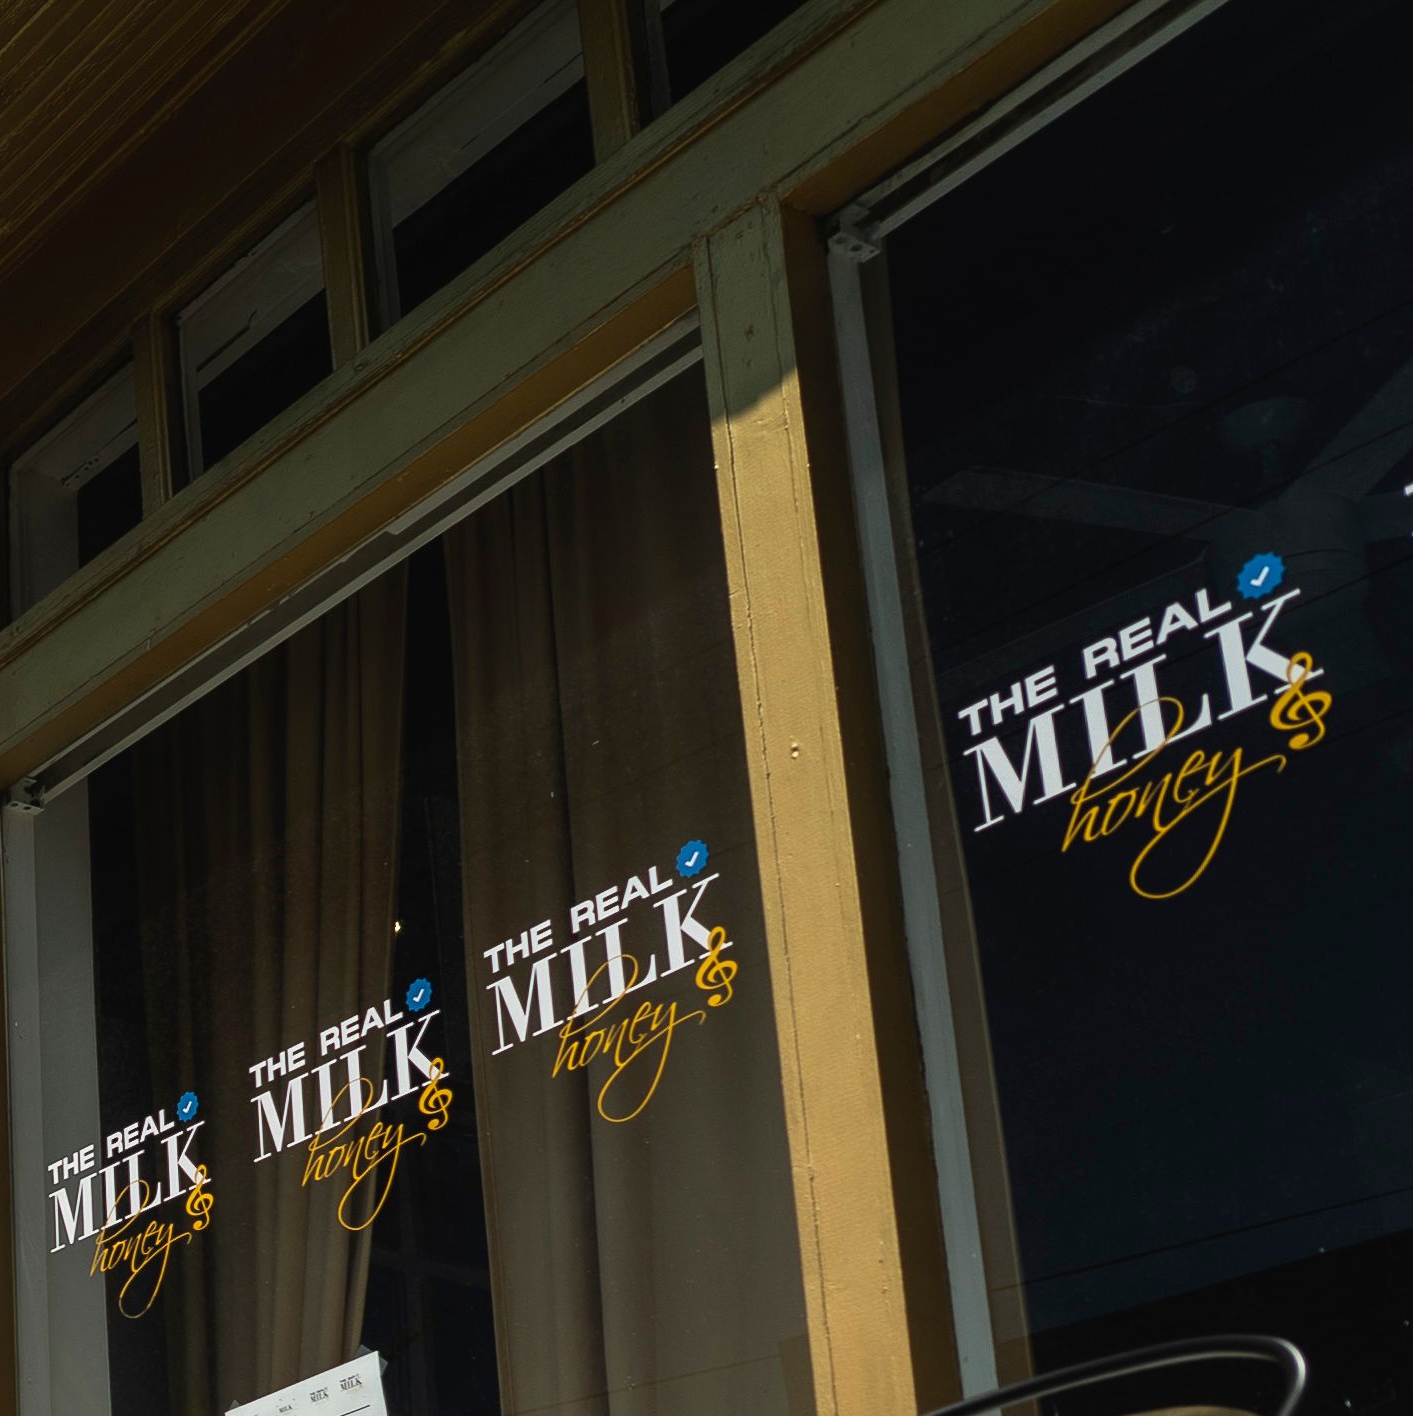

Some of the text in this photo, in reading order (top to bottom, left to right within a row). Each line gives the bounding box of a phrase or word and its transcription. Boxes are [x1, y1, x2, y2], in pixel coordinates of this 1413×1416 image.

[958, 588, 1233, 736] THE REAL
[963, 588, 1325, 833] MILK
[1061, 696, 1286, 899] honey
[483, 866, 674, 974] THE REAL
[485, 873, 734, 1056] MILK
[248, 999, 404, 1088] THE REAL
[250, 1010, 451, 1163] MILK
[550, 953, 706, 1123] honey
[48, 1108, 174, 1185] THE REAL
[49, 1120, 213, 1254] MILK
[301, 1077, 427, 1231] honey
[89, 1179, 191, 1319] honey
